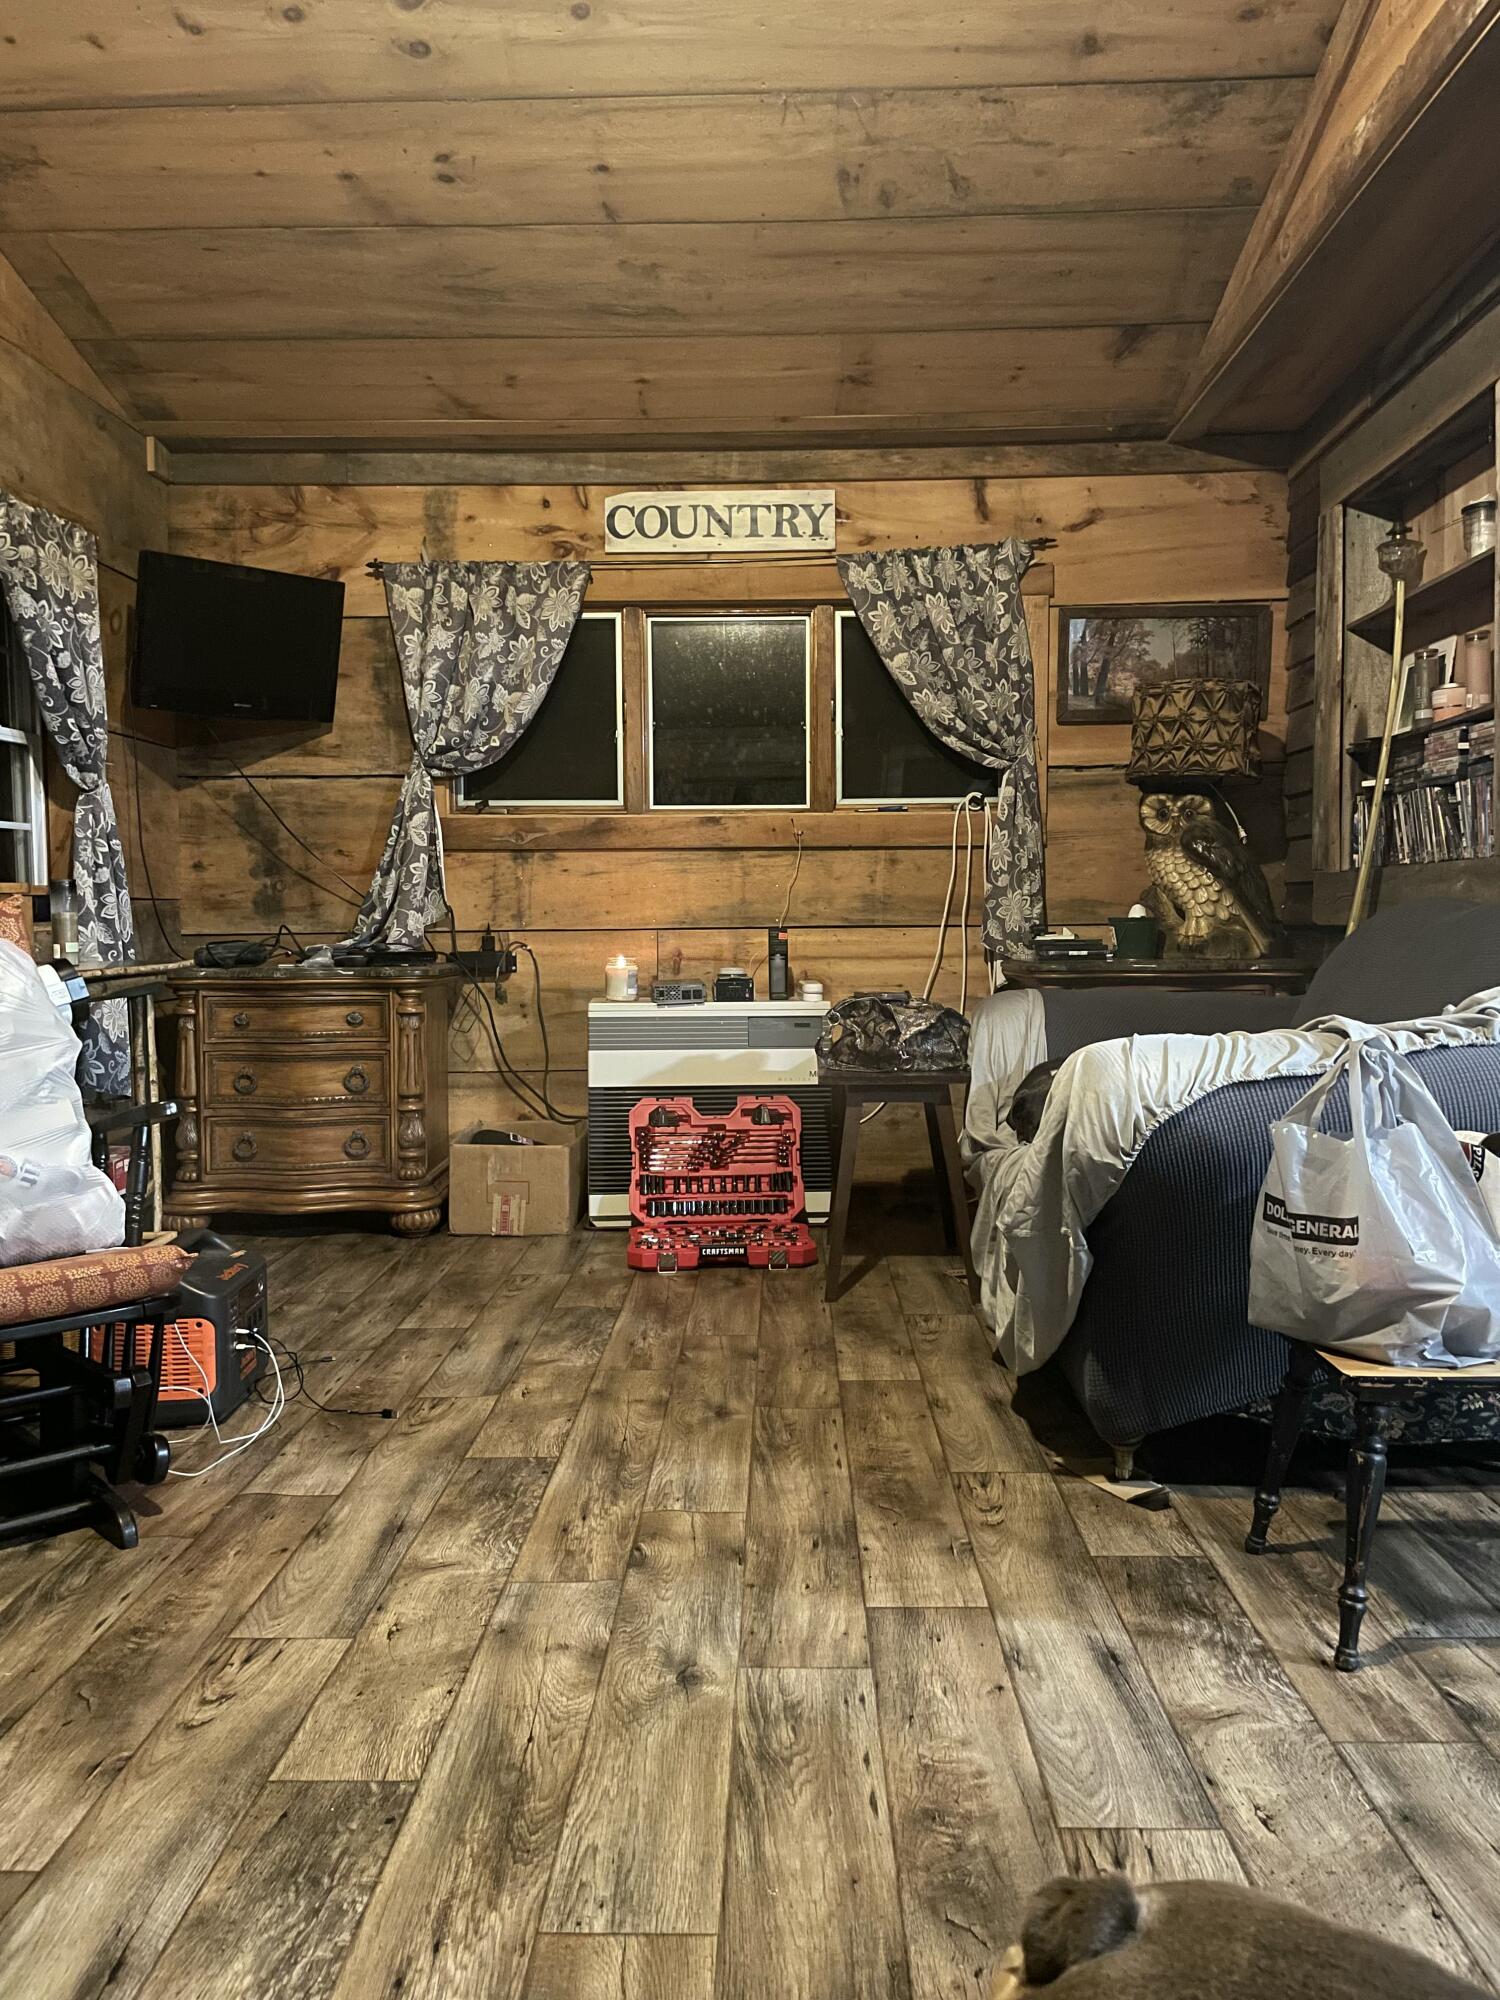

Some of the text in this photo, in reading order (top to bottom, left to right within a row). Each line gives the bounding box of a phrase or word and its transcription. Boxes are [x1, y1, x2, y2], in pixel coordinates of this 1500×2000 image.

[606, 503, 833, 539] COUNTRY
[1266, 1201, 1359, 1239] DOL GENERAL
[702, 1248, 745, 1256] CRAFTSMAN
[1312, 1247, 1337, 1258] Every
